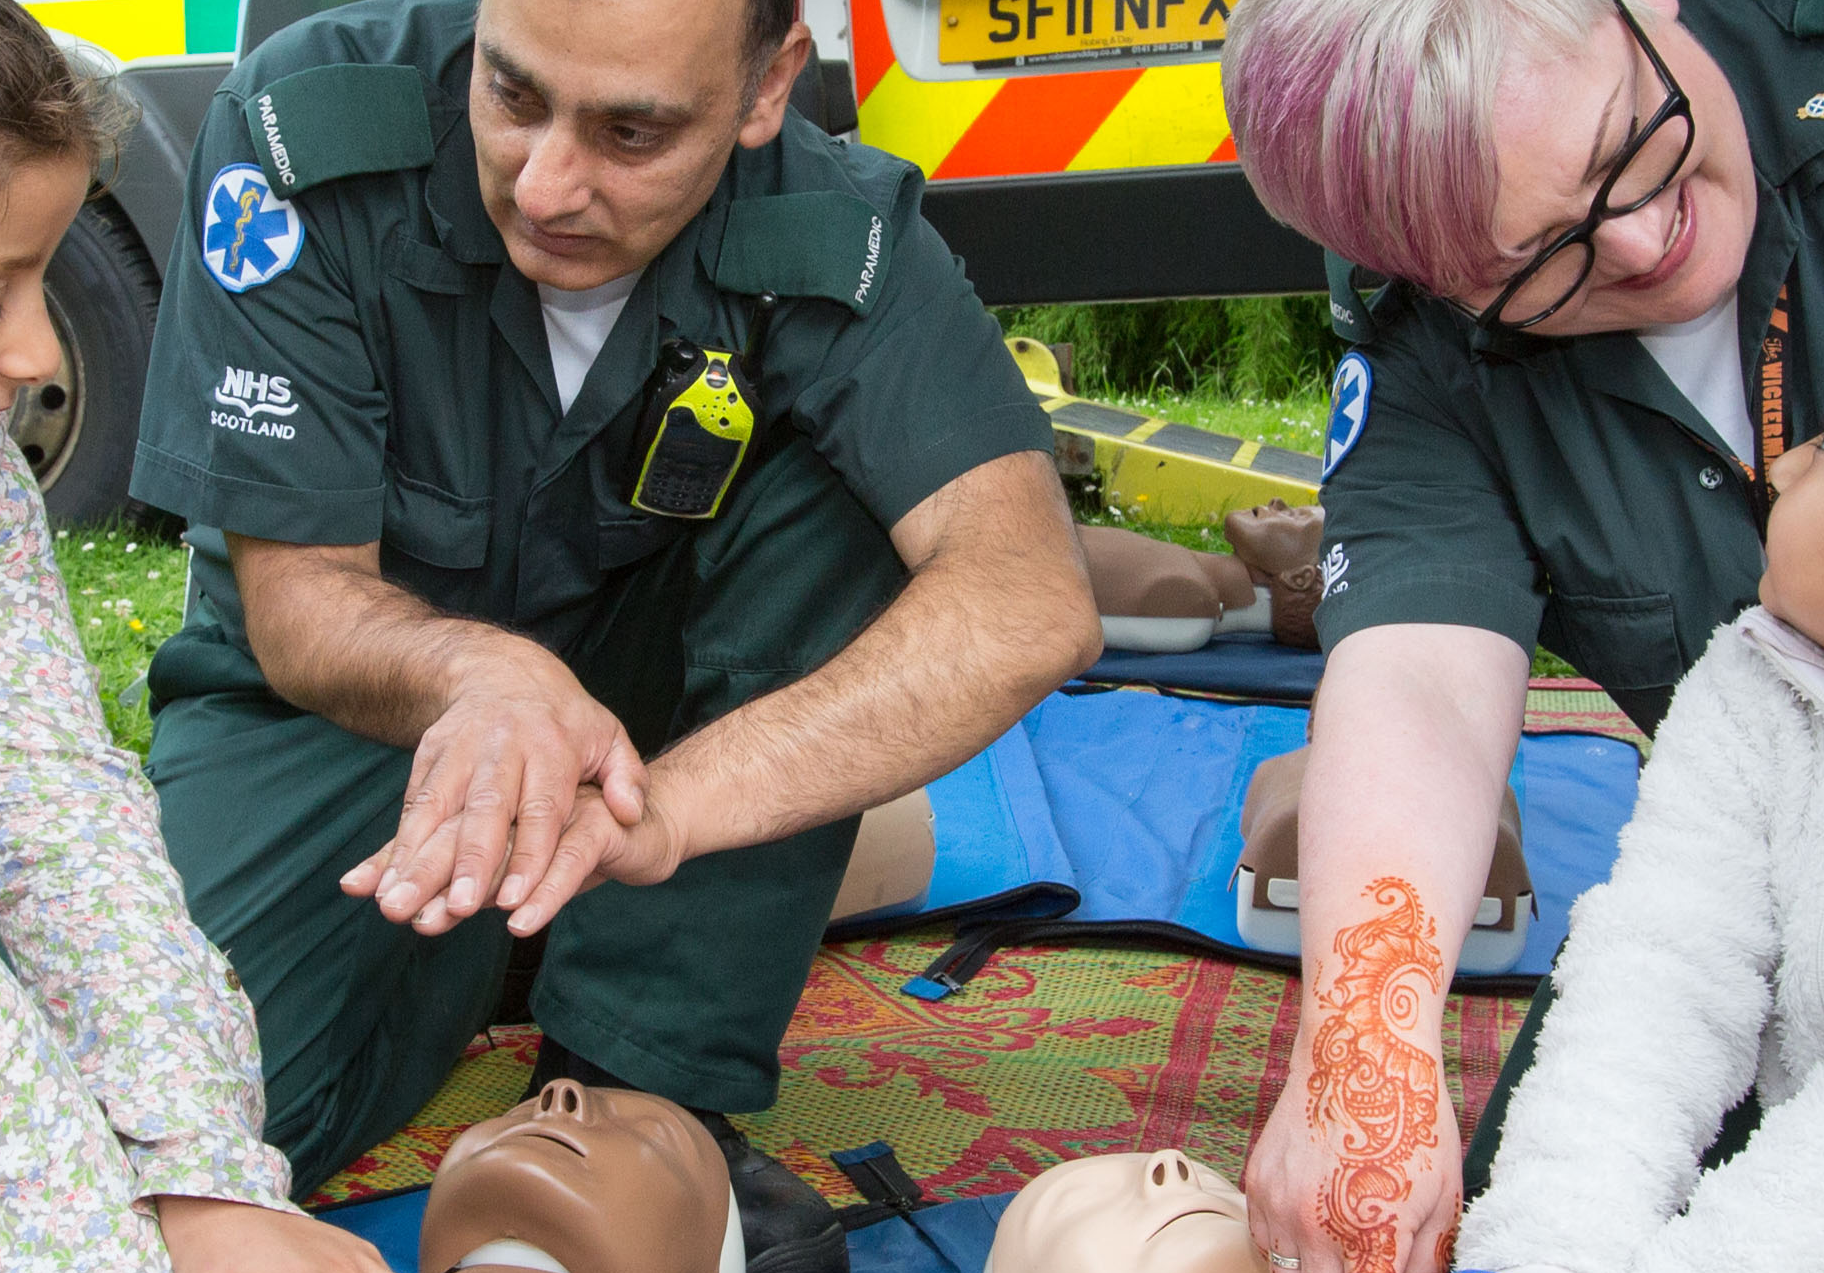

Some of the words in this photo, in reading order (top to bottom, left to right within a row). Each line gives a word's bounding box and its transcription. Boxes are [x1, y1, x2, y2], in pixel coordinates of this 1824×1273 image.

[258, 94, 296, 186] PARAMEDIC
[855, 215, 882, 304] PARAMEDIC
[211, 410, 296, 440] SCOTLAND
[221, 365, 291, 404] NHS
[1761, 361, 1784, 484] WICKERM
